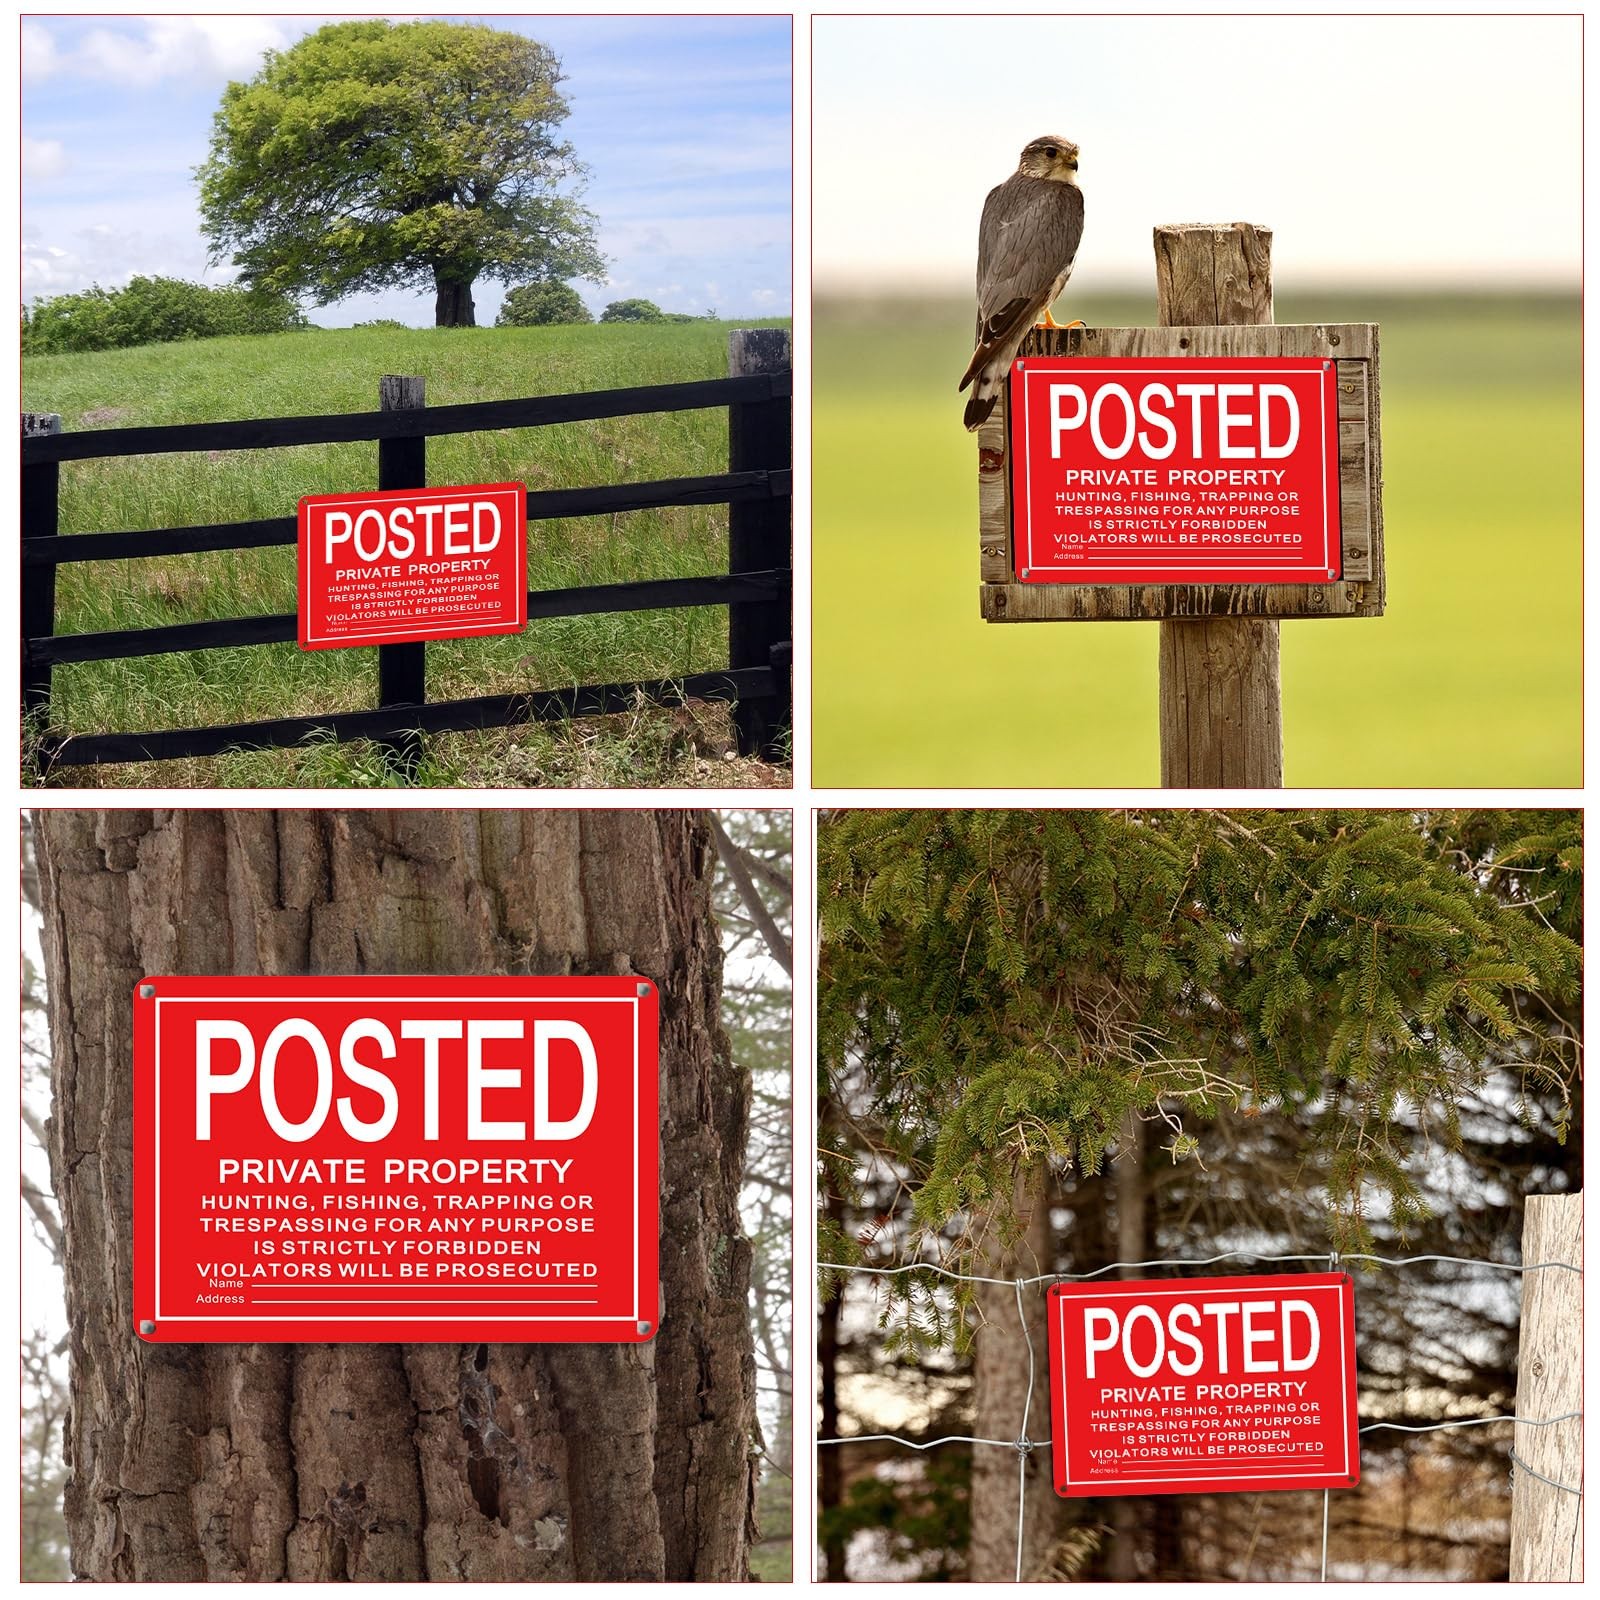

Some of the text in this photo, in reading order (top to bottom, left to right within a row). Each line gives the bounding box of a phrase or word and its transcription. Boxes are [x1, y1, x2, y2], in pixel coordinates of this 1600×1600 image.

[1050, 383, 1300, 460] POSTED
[1067, 470, 1285, 485] PRIVATE PROPERTY
[1056, 492, 1298, 502] HUNTING, FISHING, TRAPPING OR
[1055, 506, 1299, 515] TRESPASSING FOR ANY PURPOSE
[325, 501, 502, 564] POSTED
[1089, 520, 1266, 529] IS STRICTLY FORBIDDEN
[1054, 534, 1301, 544] VIOLATORS WILL BE PROSECUTED
[335, 558, 492, 581] PRIVATE PROPERTY
[328, 583, 379, 593] HUNTING,
[381, 579, 428, 589] FISHING,
[430, 574, 483, 585] TRAPPING
[328, 582, 500, 602] TRESPASSING FOR ANY PURPOSE
[351, 594, 477, 610] IS STRICTLY FORBIDDEN
[326, 601, 501, 622] VIOLATORS WILL BE PROSECUTED
[196, 1018, 598, 1142] POSTED
[220, 1159, 573, 1183] PRIVATE PROPERTY
[202, 1195, 593, 1211] HUNTING, FISHING, TRAPPING OR
[200, 1218, 594, 1232] TRESPASSING FOR ANY PURPOSE
[255, 1241, 540, 1255] IS STRICTLY FORBIDDEN
[197, 1263, 597, 1277] VIOLATORS WILL BE PROSECUTED
[209, 1278, 244, 1289] Name
[1083, 1299, 1321, 1379] POSTED
[1100, 1381, 1307, 1404] PRIVATE PROPERTY
[1091, 1402, 1320, 1419] HUNTING, FISHING, TRAPPING OR
[1090, 1415, 1321, 1433] TRESPASSING FOR ANY PURPOSE
[1122, 1430, 1291, 1445] IS STRICTLY FORBIDDEN
[1089, 1441, 1324, 1460] VIOLATORS WILL BE PROSECUTED
